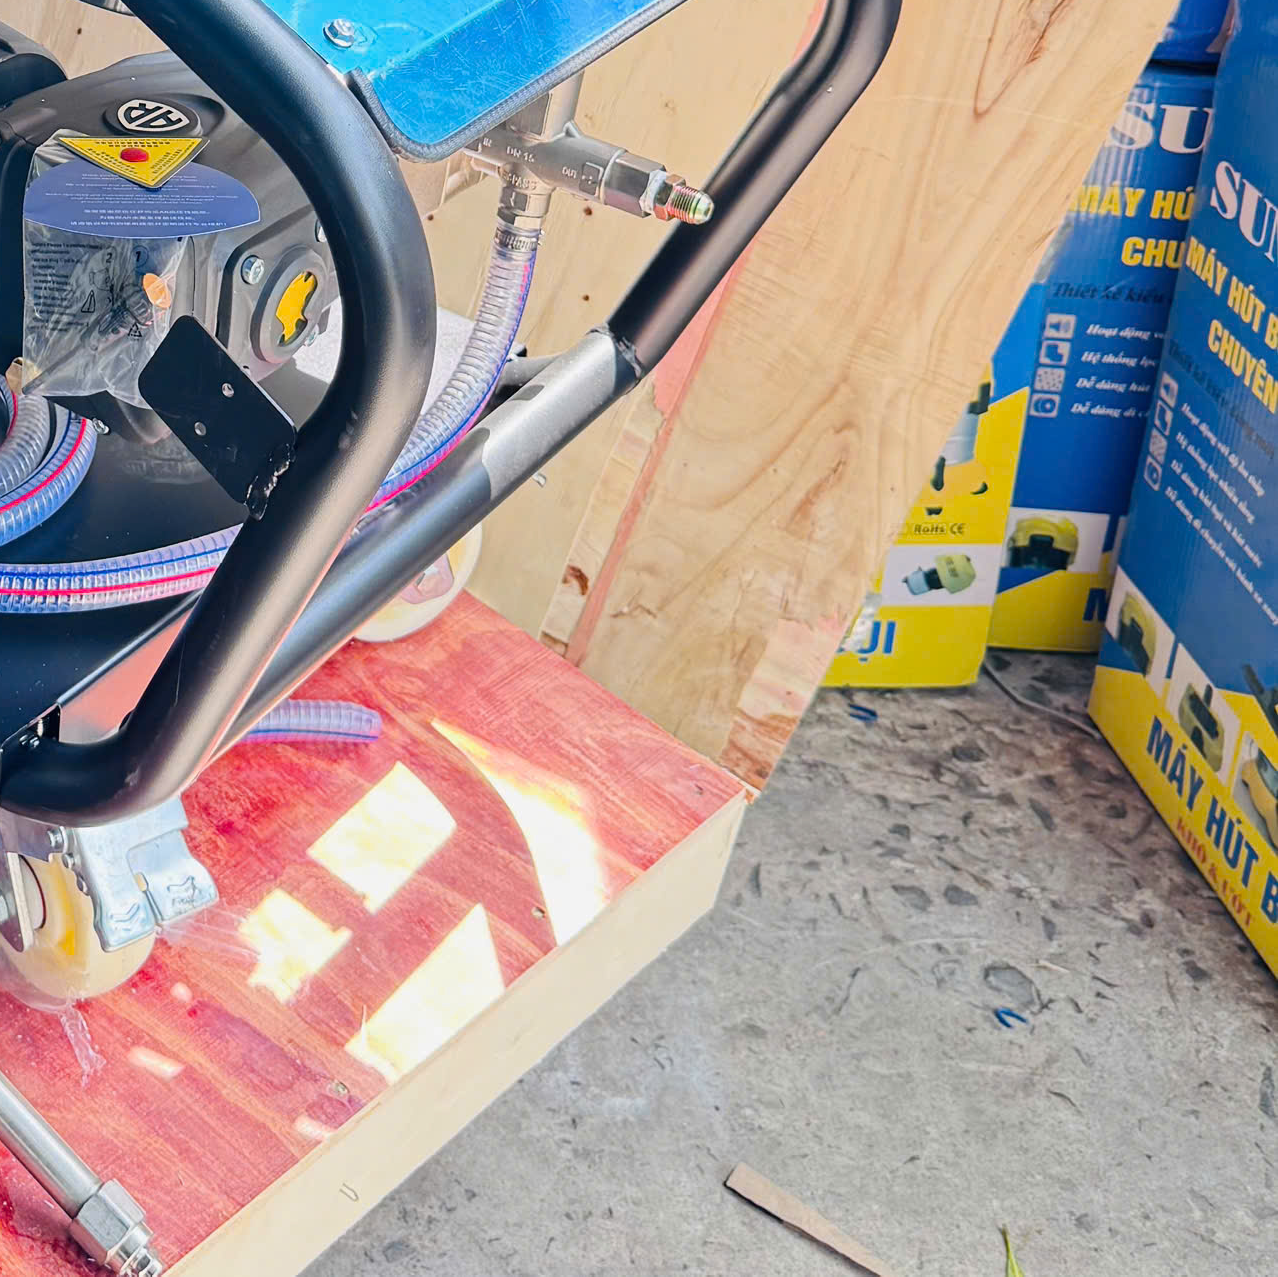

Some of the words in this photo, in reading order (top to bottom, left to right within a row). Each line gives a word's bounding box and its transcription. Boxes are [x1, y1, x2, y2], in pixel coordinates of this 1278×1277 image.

[1186, 236, 1229, 296] MÁY
[1227, 276, 1265, 333] HÚT
[1146, 715, 1204, 811] MÁY
[1205, 795, 1259, 888] HÚT
